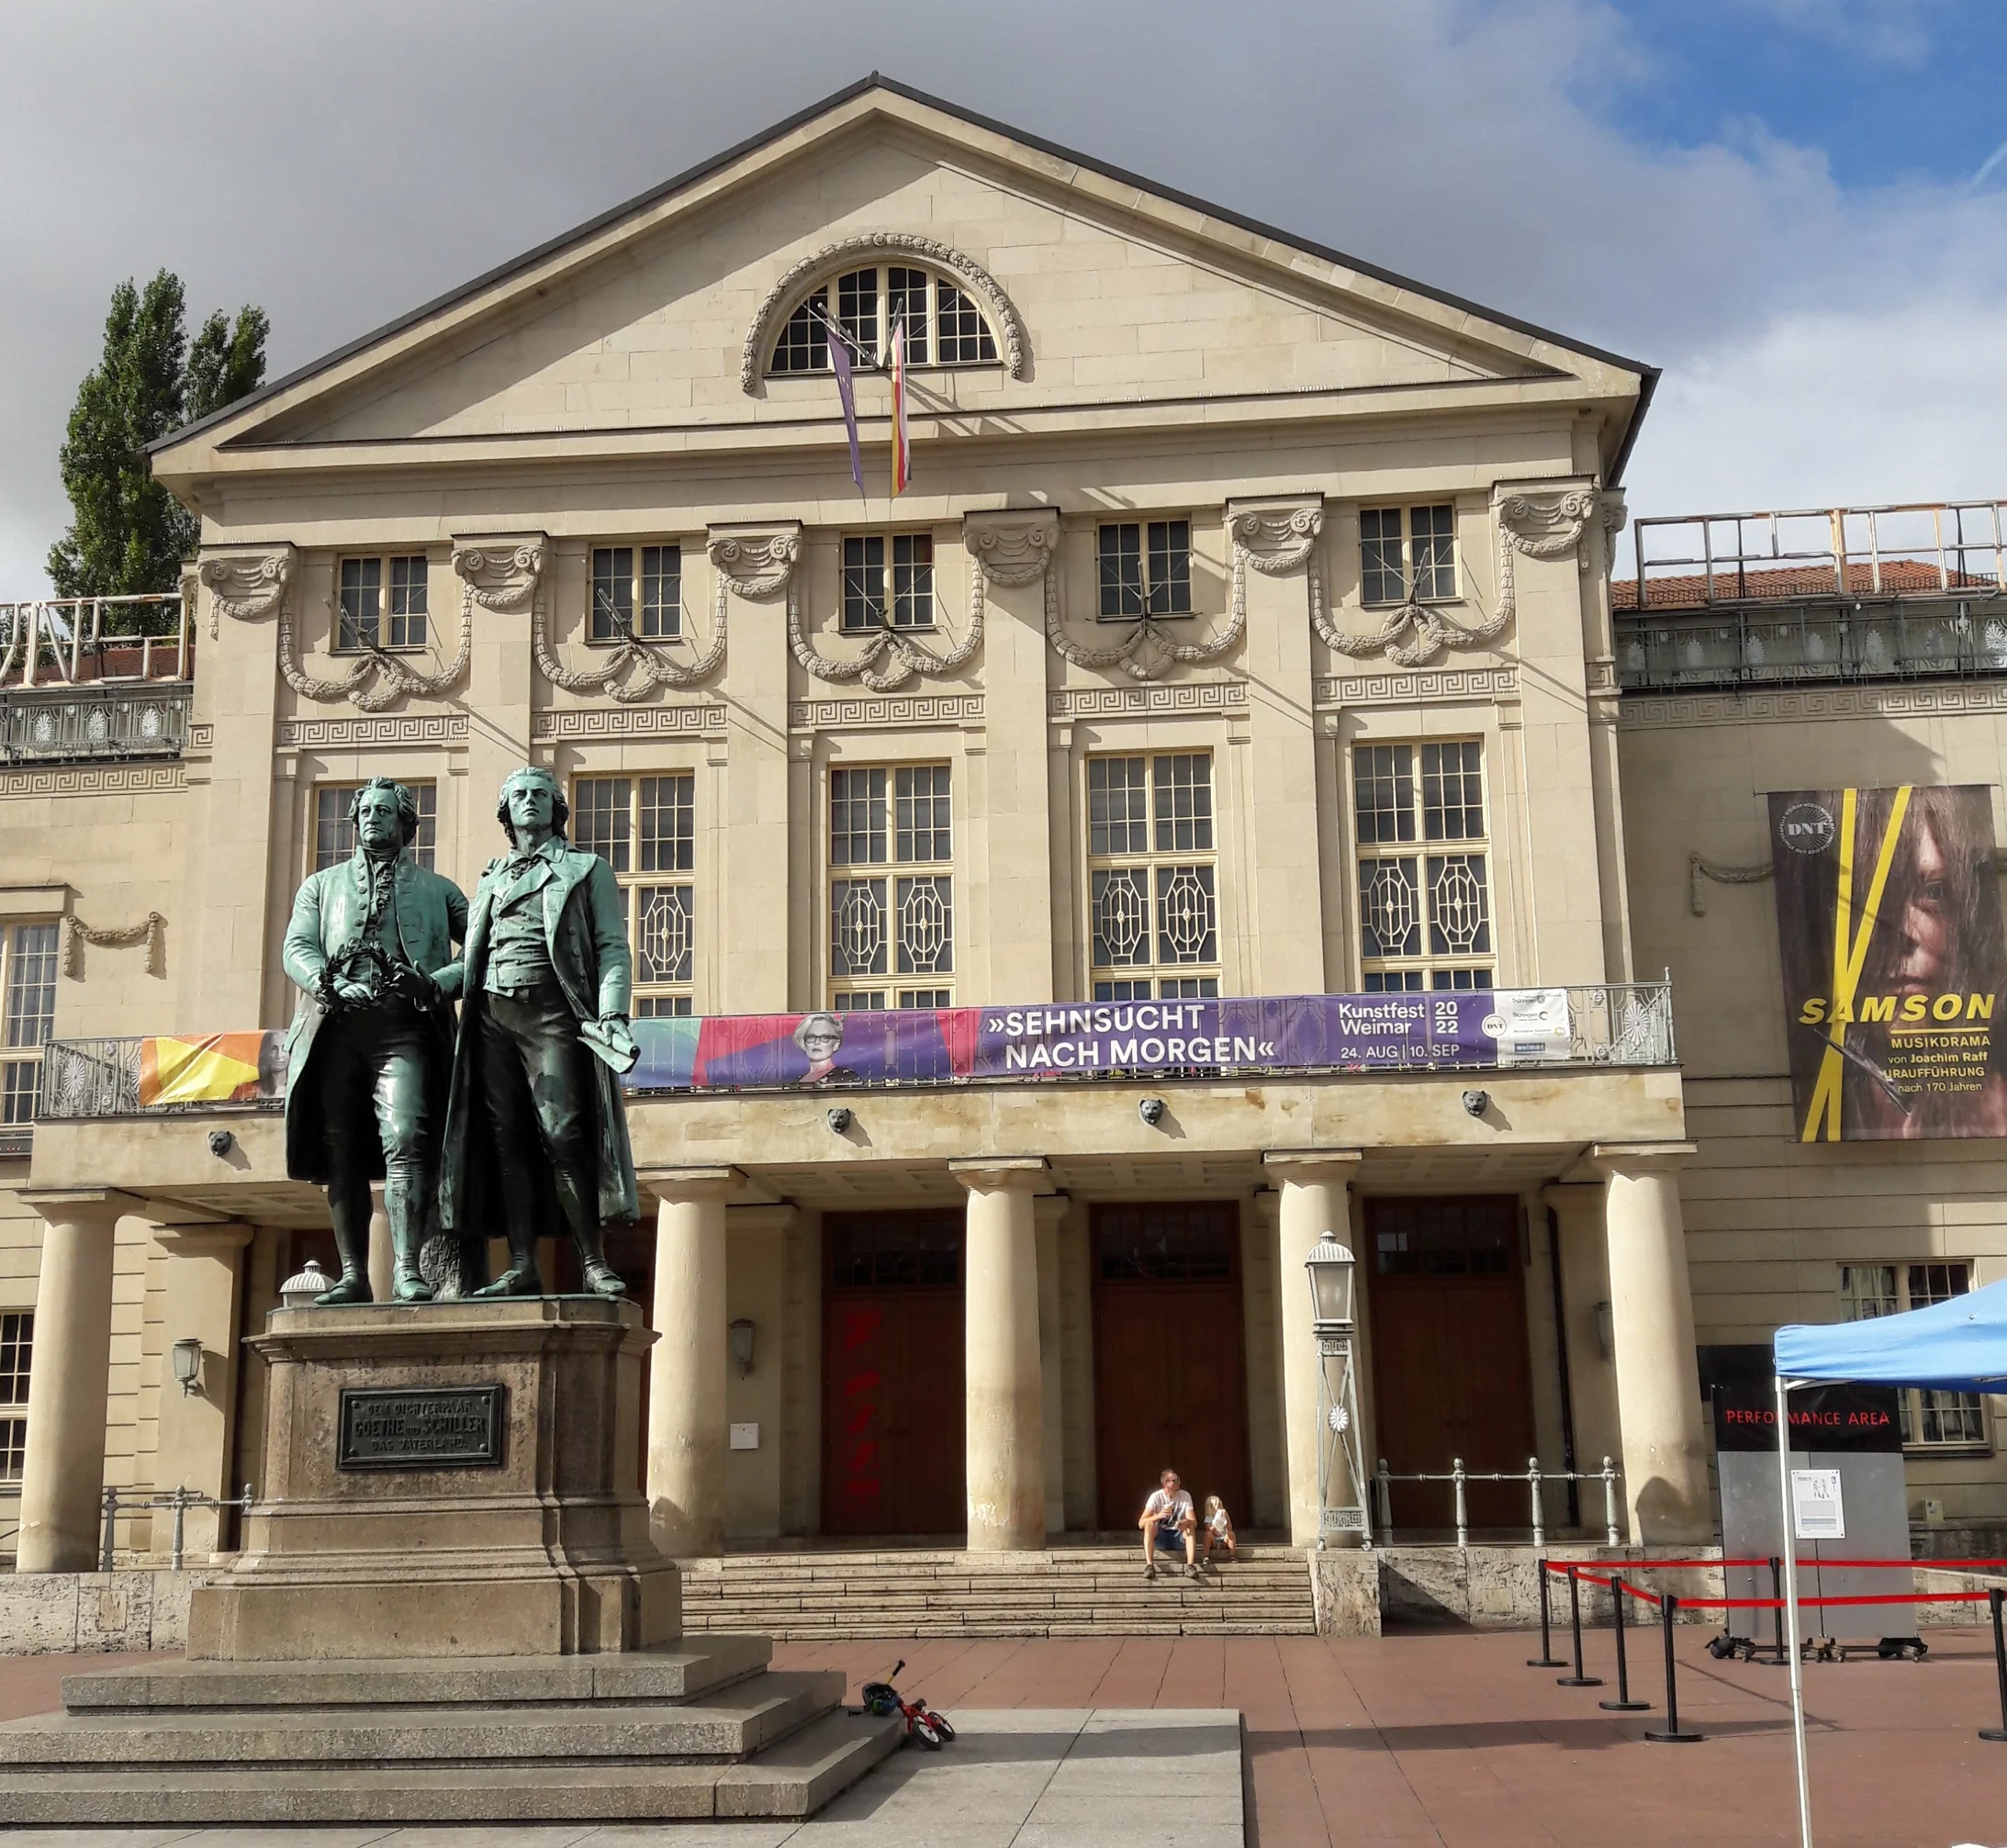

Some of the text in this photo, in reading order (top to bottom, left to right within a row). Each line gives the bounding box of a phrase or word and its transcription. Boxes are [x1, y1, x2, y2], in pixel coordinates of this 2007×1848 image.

[1788, 823, 1827, 835] DNT
[1339, 1002, 1425, 1018] Kunstfest
[1435, 1001, 1458, 1015] 20
[1799, 993, 1995, 1025] SAMSON
[988, 1004, 1205, 1036] »SEHNSUCHT
[1340, 1019, 1412, 1036] Weimar
[1436, 1021, 1459, 1034] 22
[1891, 1036, 1990, 1048] MUSIKDRAMA
[1005, 1036, 1274, 1069] NACH MORGEN«
[1341, 1047, 1361, 1058] 24.
[1366, 1046, 1397, 1058] AUG
[1409, 1046, 1428, 1058] 10.
[1432, 1044, 1460, 1057] SEP
[1888, 1051, 1988, 1064] von Joachim Raff
[1884, 1066, 1985, 1079] URAUFFÜHRUNG
[1898, 1082, 1982, 1092] nach 170 Jahren
[368, 1403, 390, 1415] DEM
[1725, 1410, 1890, 1425] PERFOMANCE AREA
[354, 1417, 405, 1437] GOETHE
[372, 1439, 394, 1450] DAS
